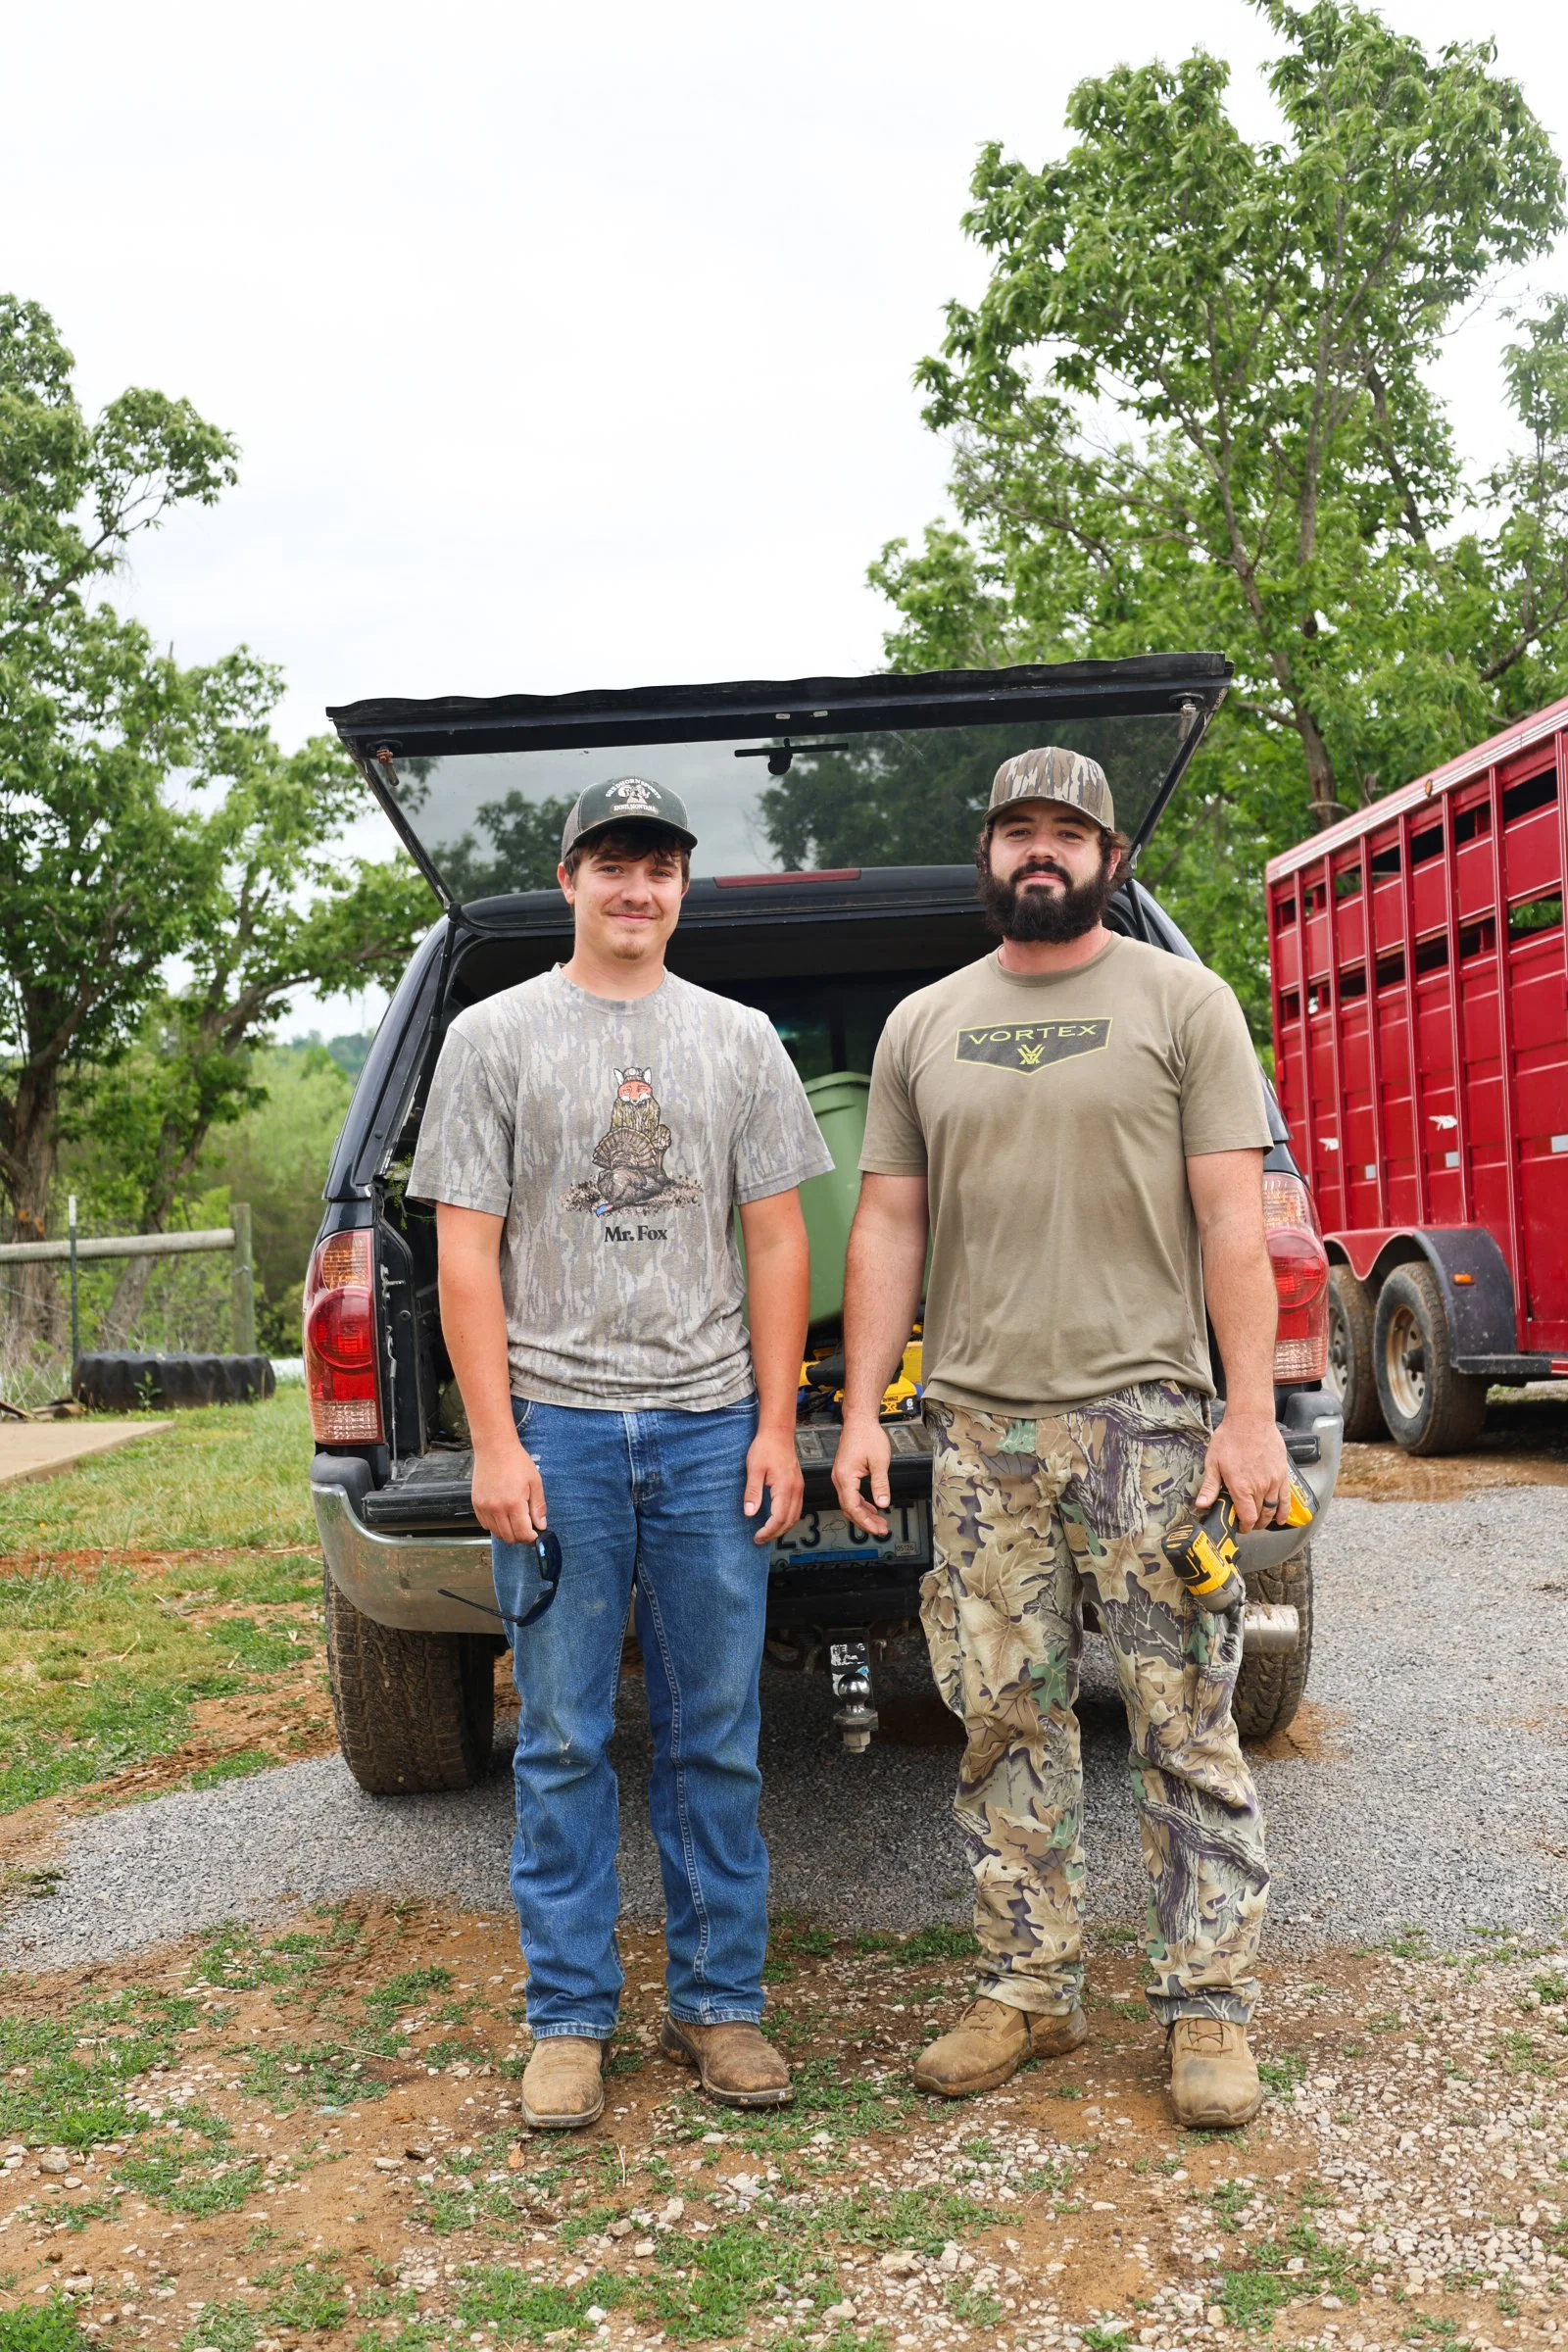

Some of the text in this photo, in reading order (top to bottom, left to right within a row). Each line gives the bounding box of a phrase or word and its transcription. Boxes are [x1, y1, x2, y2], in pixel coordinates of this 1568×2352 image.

[969, 1025, 1098, 1045] VORTEX
[605, 1225, 667, 1242] Mr. Fox
[906, 1397, 913, 1407] 6
